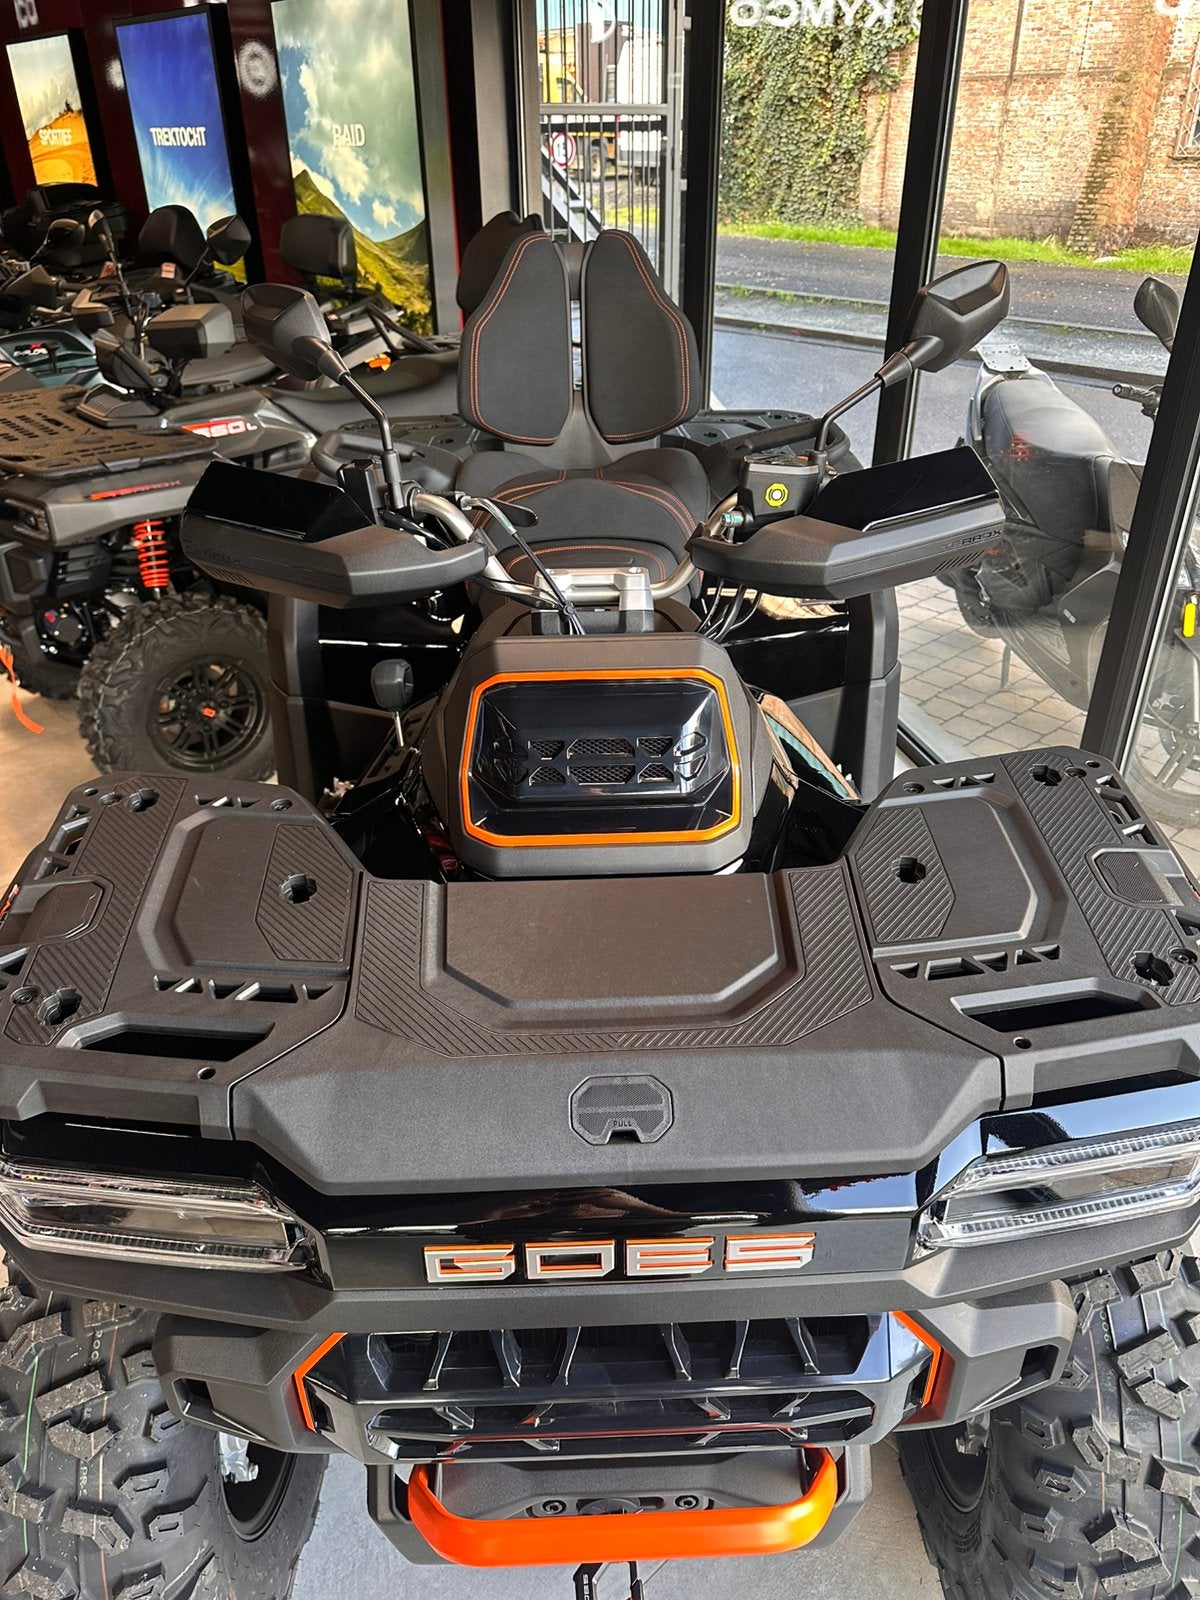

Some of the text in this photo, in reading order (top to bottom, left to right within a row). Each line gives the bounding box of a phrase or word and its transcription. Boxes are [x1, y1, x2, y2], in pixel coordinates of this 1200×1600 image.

[38, 128, 73, 146] SPORTIEF
[149, 126, 207, 147] TREKTOCHT
[332, 123, 366, 148] RAID
[423, 1231, 816, 1283] GOES
